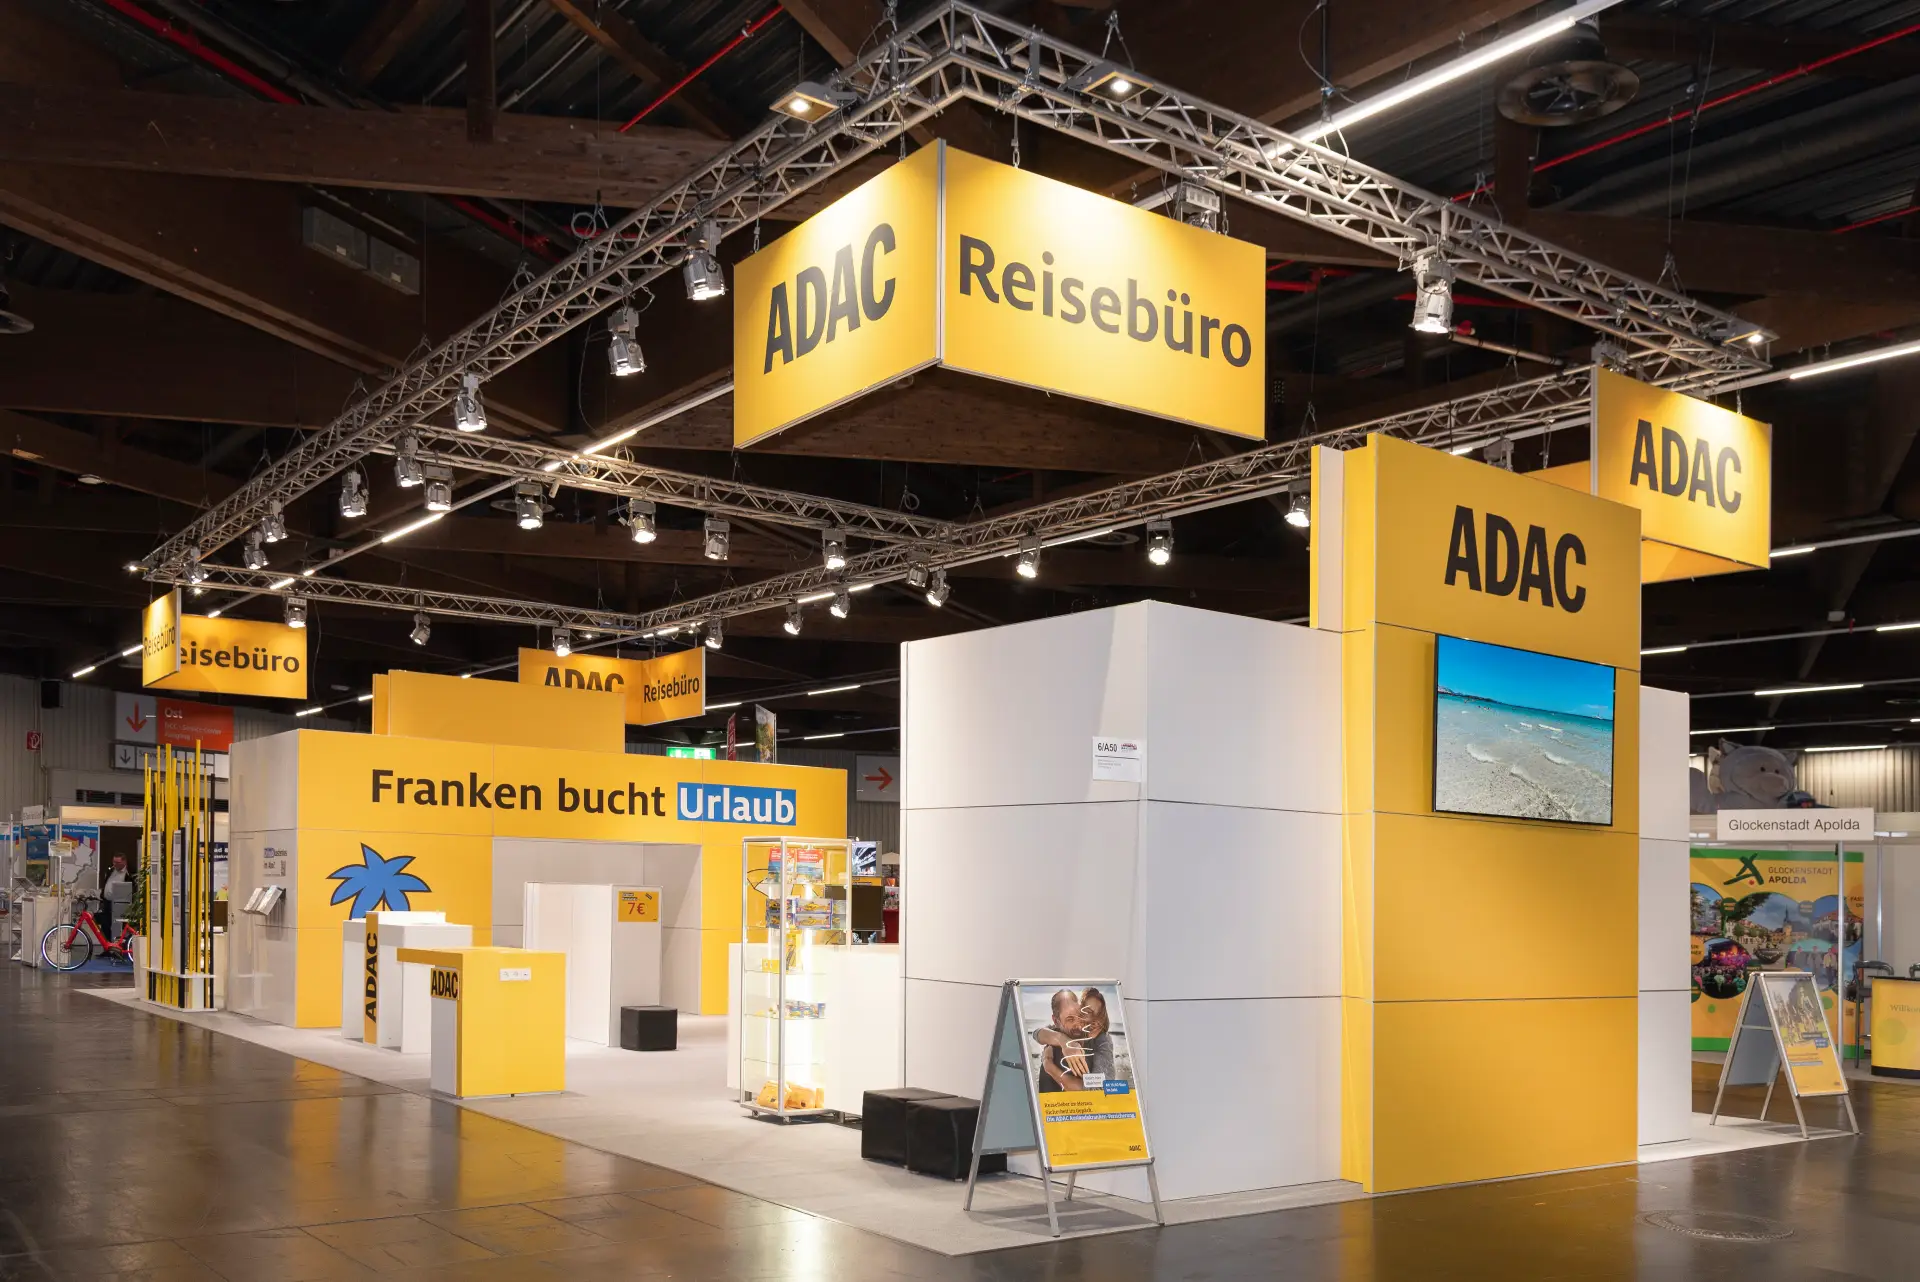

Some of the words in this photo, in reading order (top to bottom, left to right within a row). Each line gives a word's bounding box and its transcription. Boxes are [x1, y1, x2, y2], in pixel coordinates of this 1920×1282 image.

[763, 222, 896, 374] ADAC
[959, 233, 1251, 367] Reisebüro
[1630, 419, 1741, 514] ADAC
[1444, 504, 1587, 614] ADAC
[143, 623, 175, 660] Reisebüro
[181, 641, 300, 673] eisebüro
[543, 666, 624, 692] ADAC
[643, 674, 700, 703] Reisebüro
[164, 707, 183, 719] Ost
[1097, 742, 1118, 752] 6/A50
[372, 768, 543, 811] Franken
[558, 777, 666, 816] bucht
[680, 787, 795, 824] Urlaub
[1728, 819, 1810, 831] Glockenstadt
[1814, 819, 1860, 833] Apolda
[1768, 866, 1833, 875] GLOCKENSTADT
[1768, 876, 1807, 884] APOLDA
[365, 932, 378, 1024] ADAC
[431, 970, 459, 999] ADAC
[1129, 1144, 1142, 1152] ADAC
